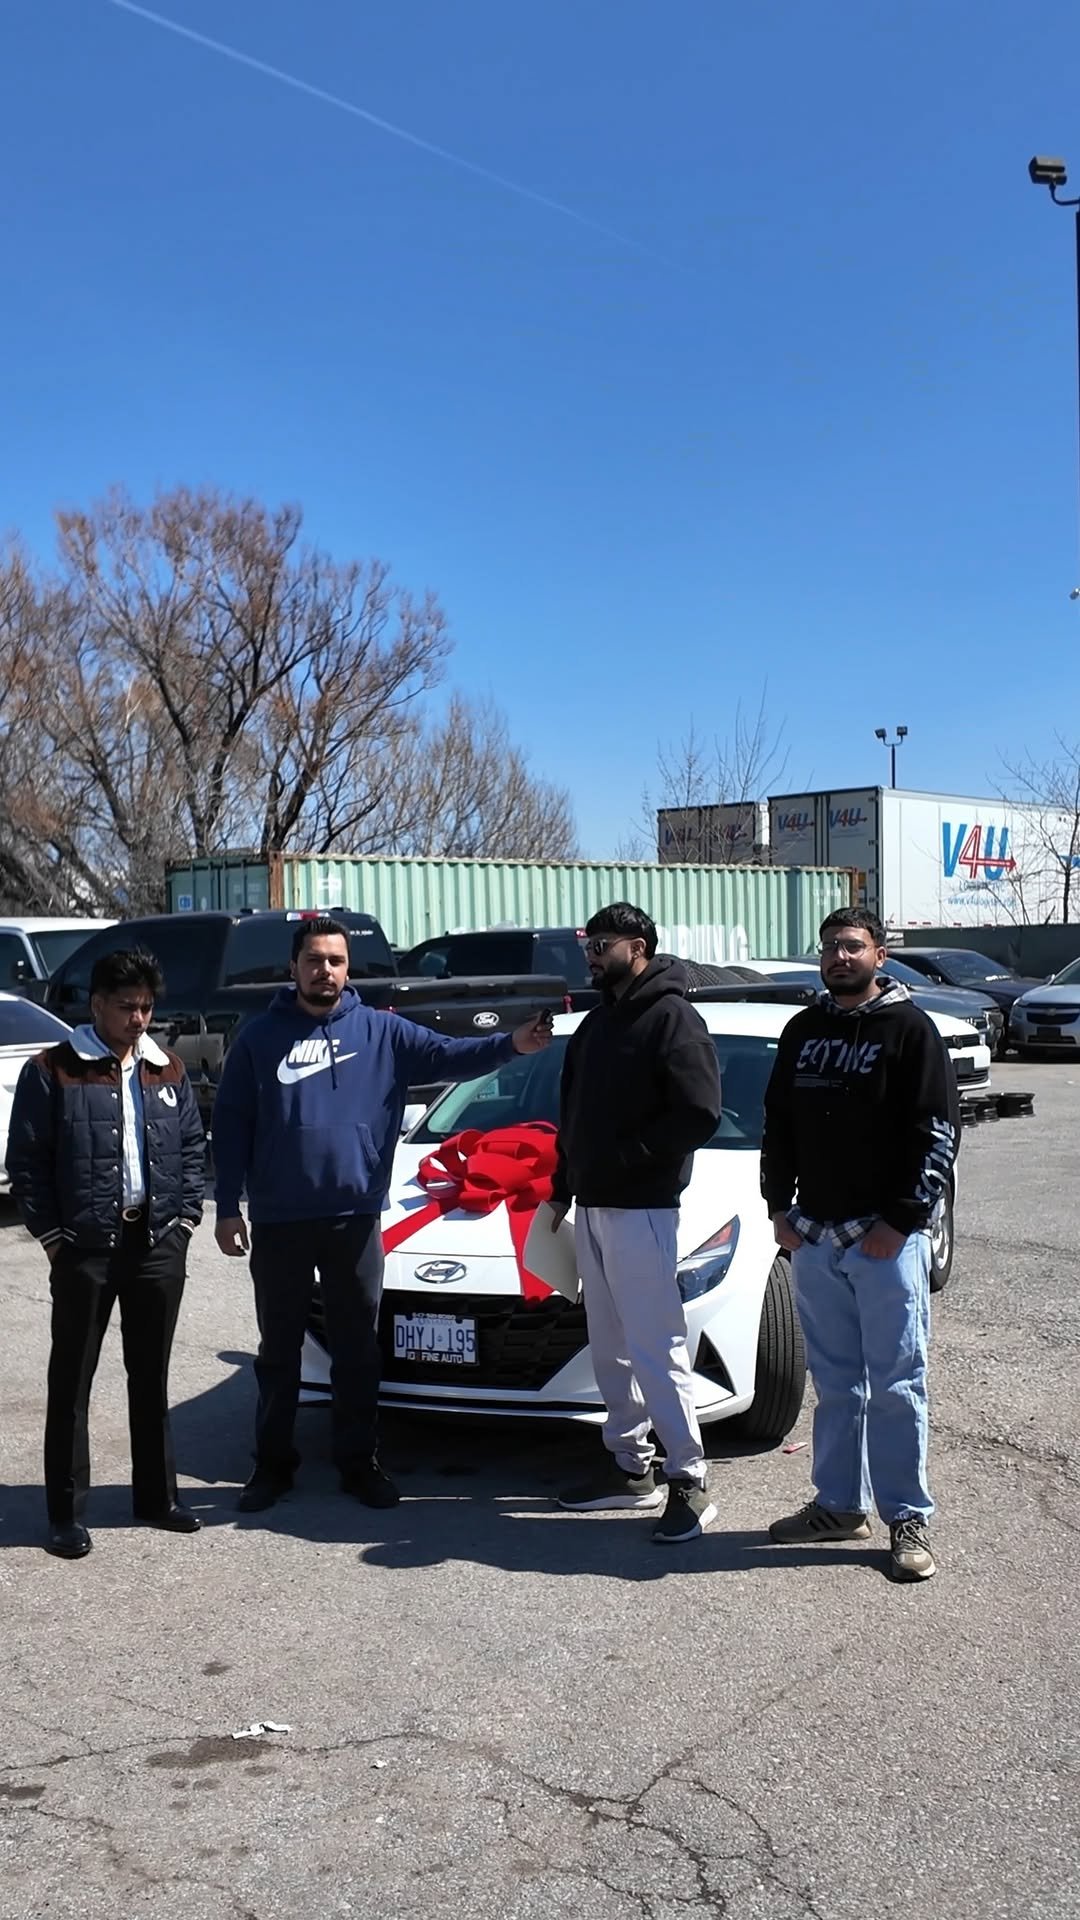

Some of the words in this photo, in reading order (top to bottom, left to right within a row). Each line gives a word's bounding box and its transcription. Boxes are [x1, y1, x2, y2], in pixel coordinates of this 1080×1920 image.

[778, 812, 812, 832] V4U
[830, 807, 865, 828] V4U
[942, 821, 1012, 881] V4U
[396, 1325, 435, 1350] DHYJ
[447, 1328, 476, 1352] 195
[422, 1352, 440, 1362] FINE
[440, 1353, 463, 1364] AUTO
